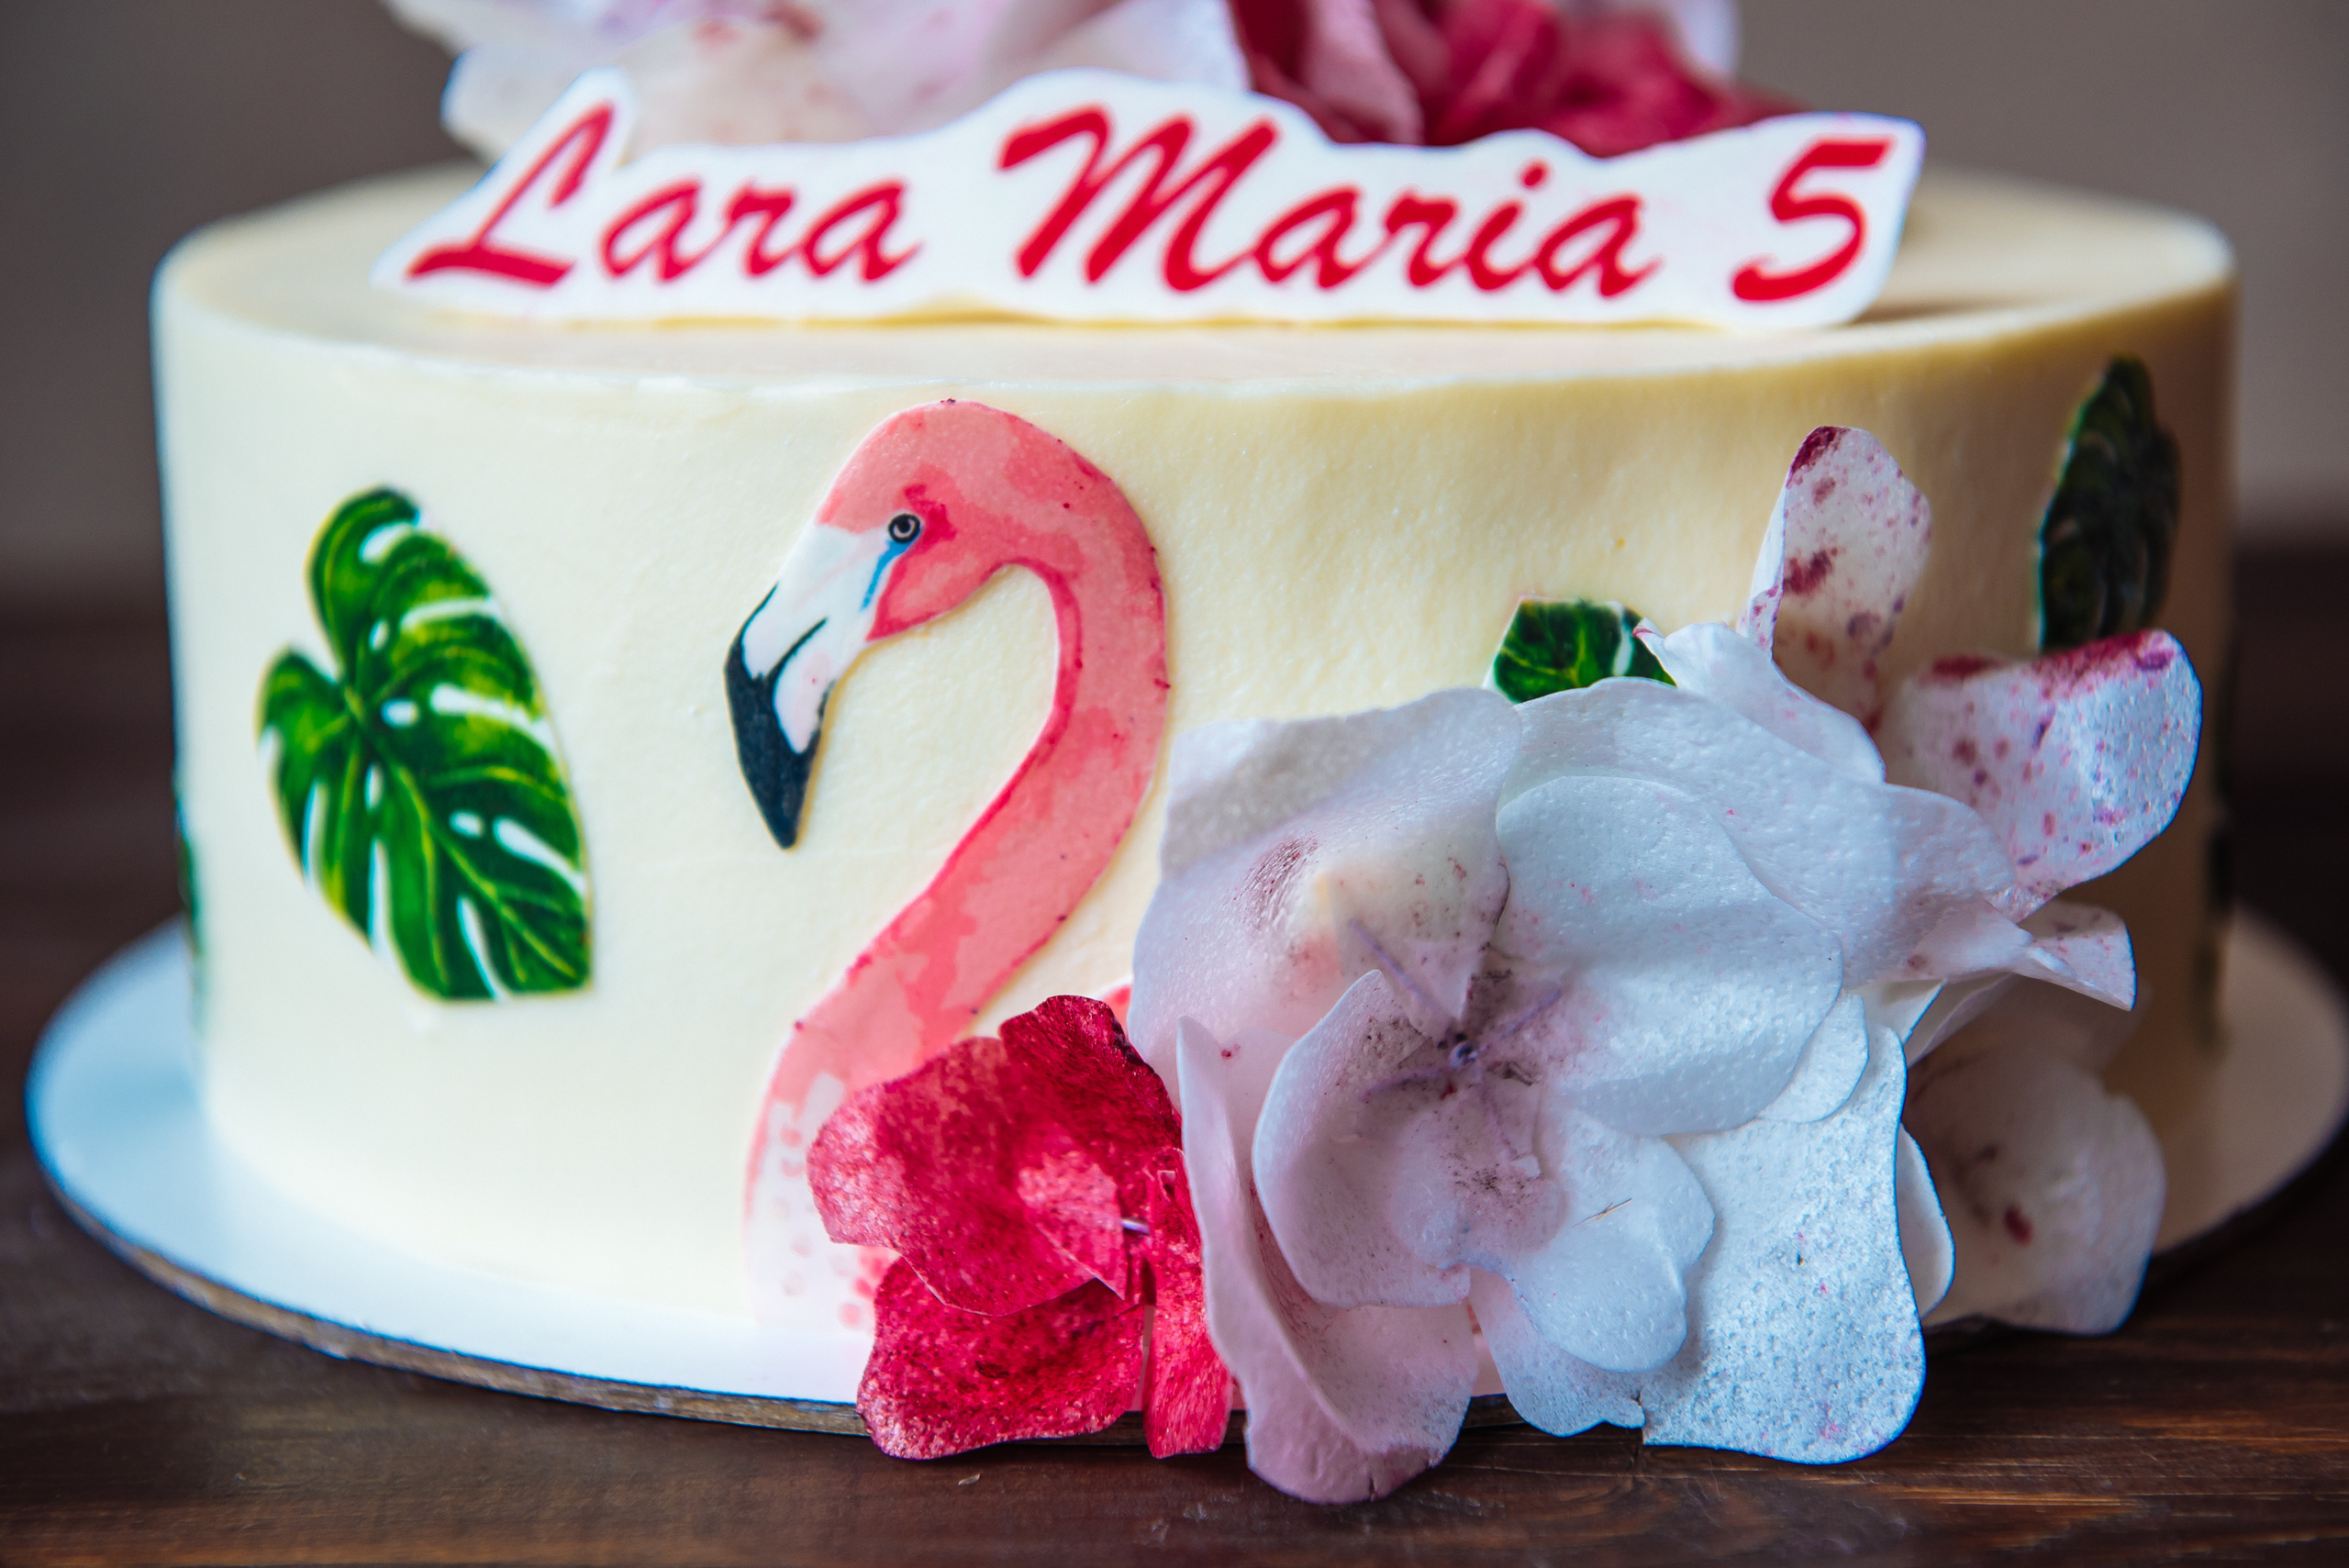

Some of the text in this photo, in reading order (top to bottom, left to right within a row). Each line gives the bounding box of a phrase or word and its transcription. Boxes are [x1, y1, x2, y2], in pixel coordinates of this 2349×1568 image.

[406, 103, 1892, 305] Lara Maria 5
